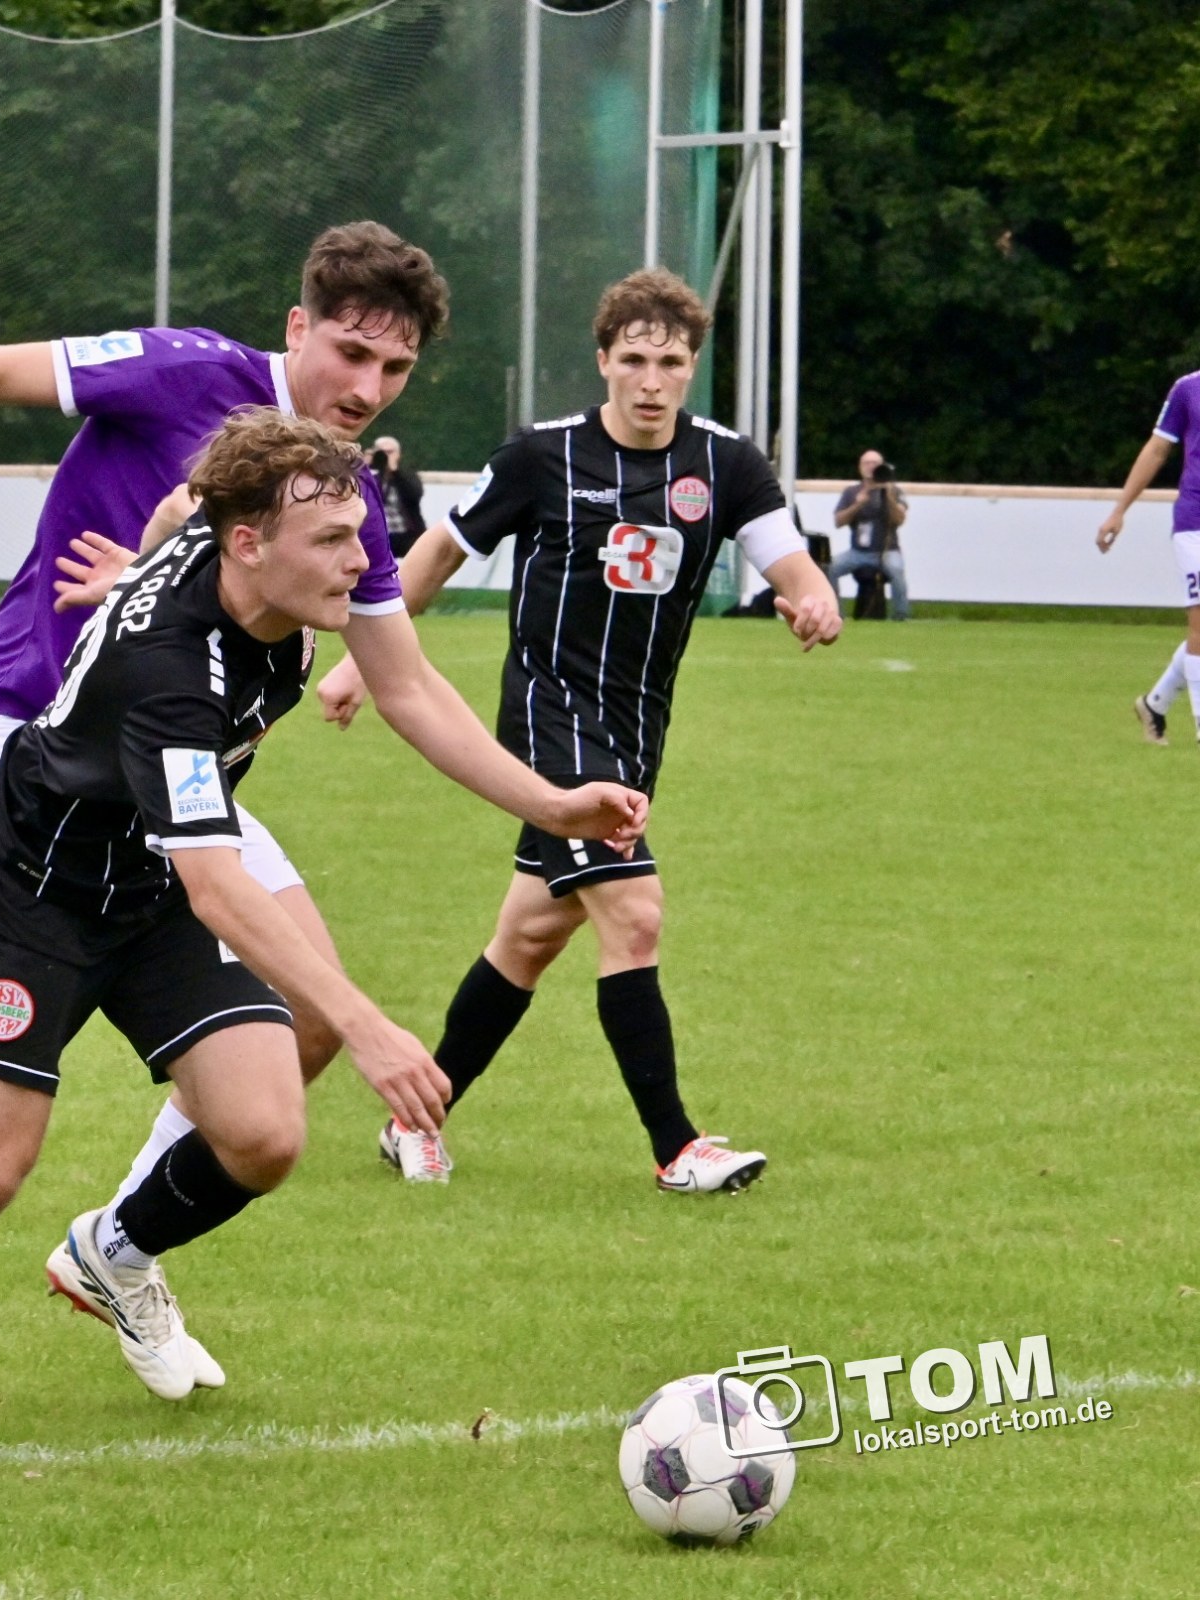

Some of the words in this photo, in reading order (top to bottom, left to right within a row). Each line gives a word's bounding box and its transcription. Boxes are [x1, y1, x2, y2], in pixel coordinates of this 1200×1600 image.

[572, 488, 617, 501] capelli
[1186, 572, 1200, 599] 2
[178, 801, 219, 815] BAYERN
